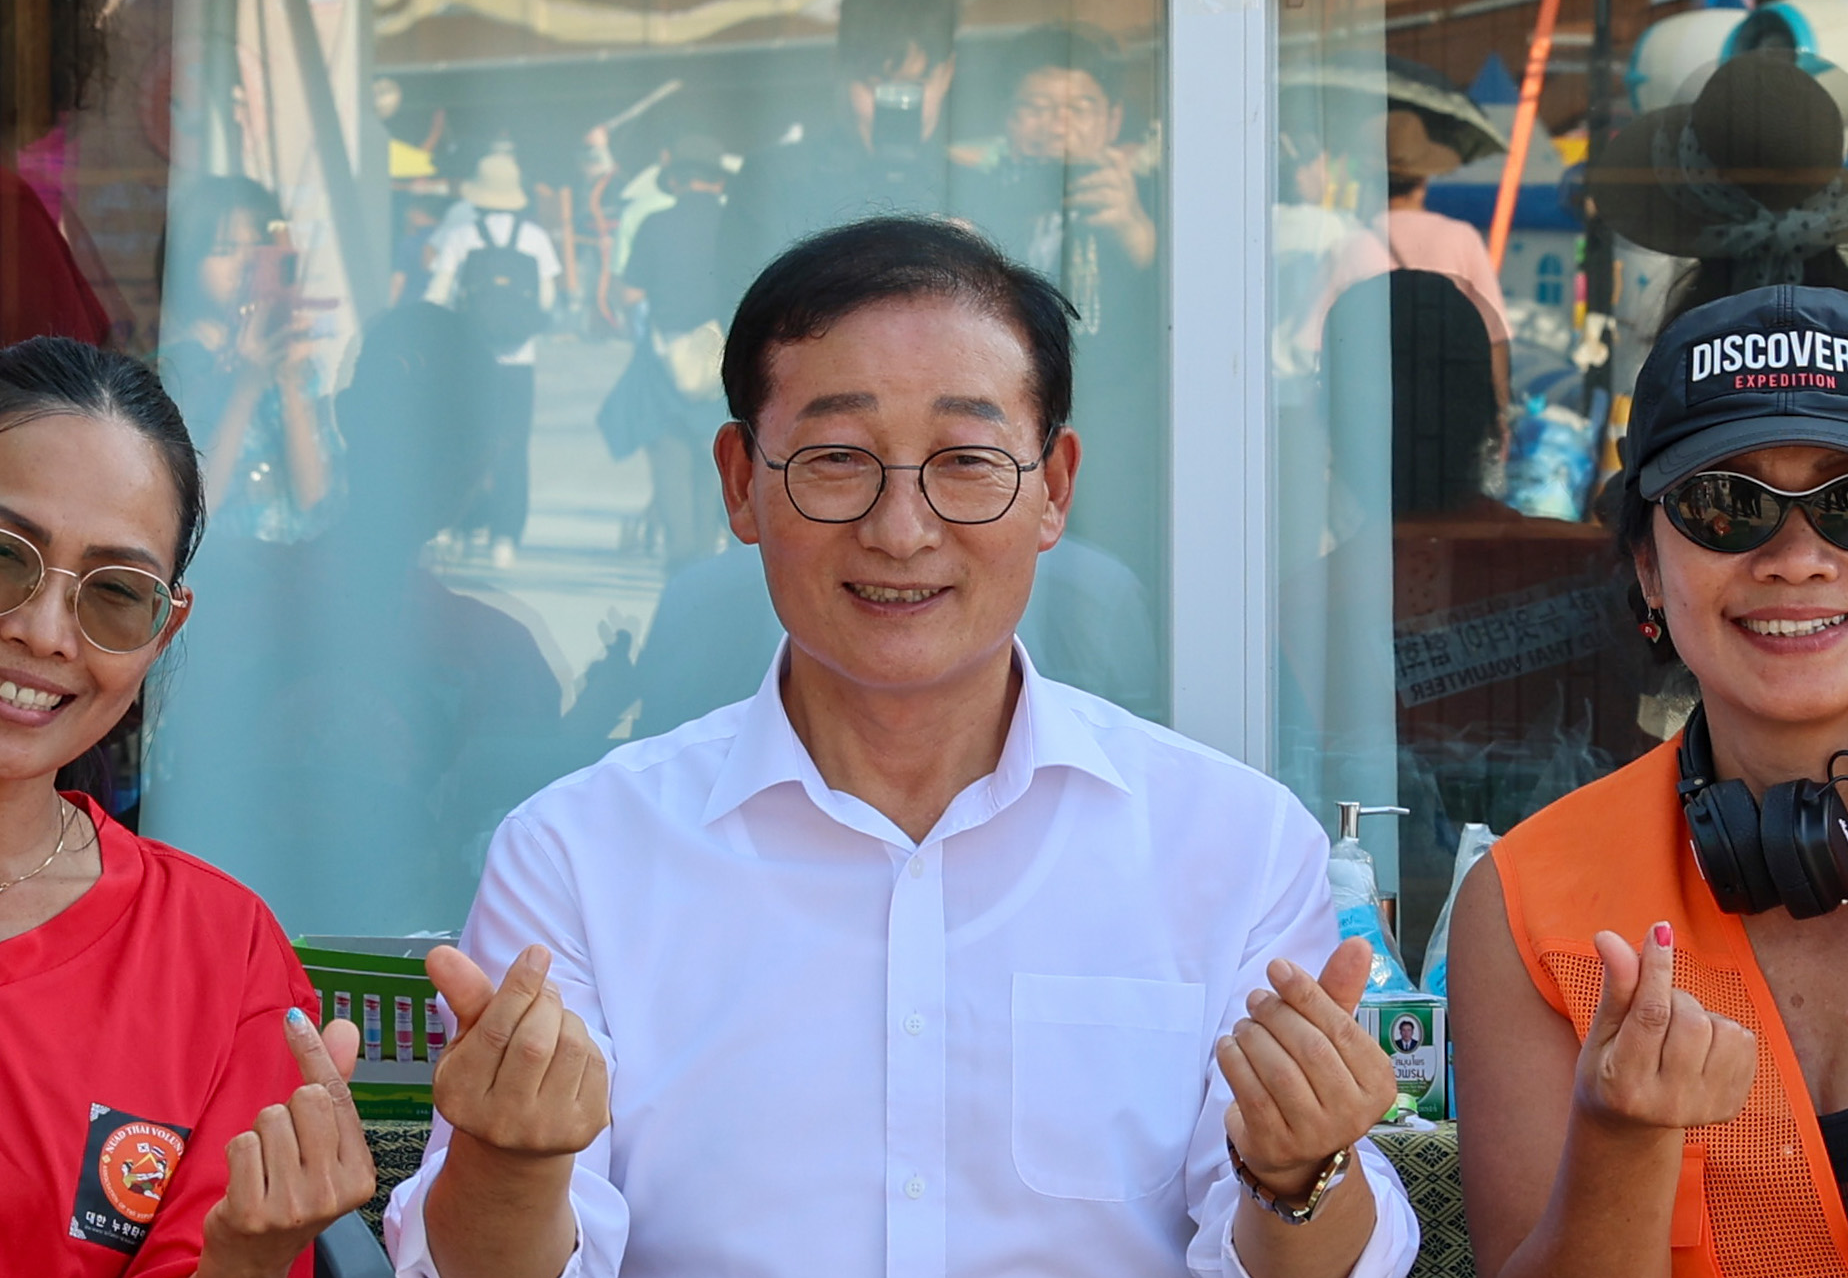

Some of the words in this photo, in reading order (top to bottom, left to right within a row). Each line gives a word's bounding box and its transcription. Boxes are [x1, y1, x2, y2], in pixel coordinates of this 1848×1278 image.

[1734, 373, 1837, 390] EXPEDITION
[105, 1129, 127, 1154] NUAD
[125, 1125, 150, 1135] THAI
[151, 1125, 185, 1156] VOLUN
